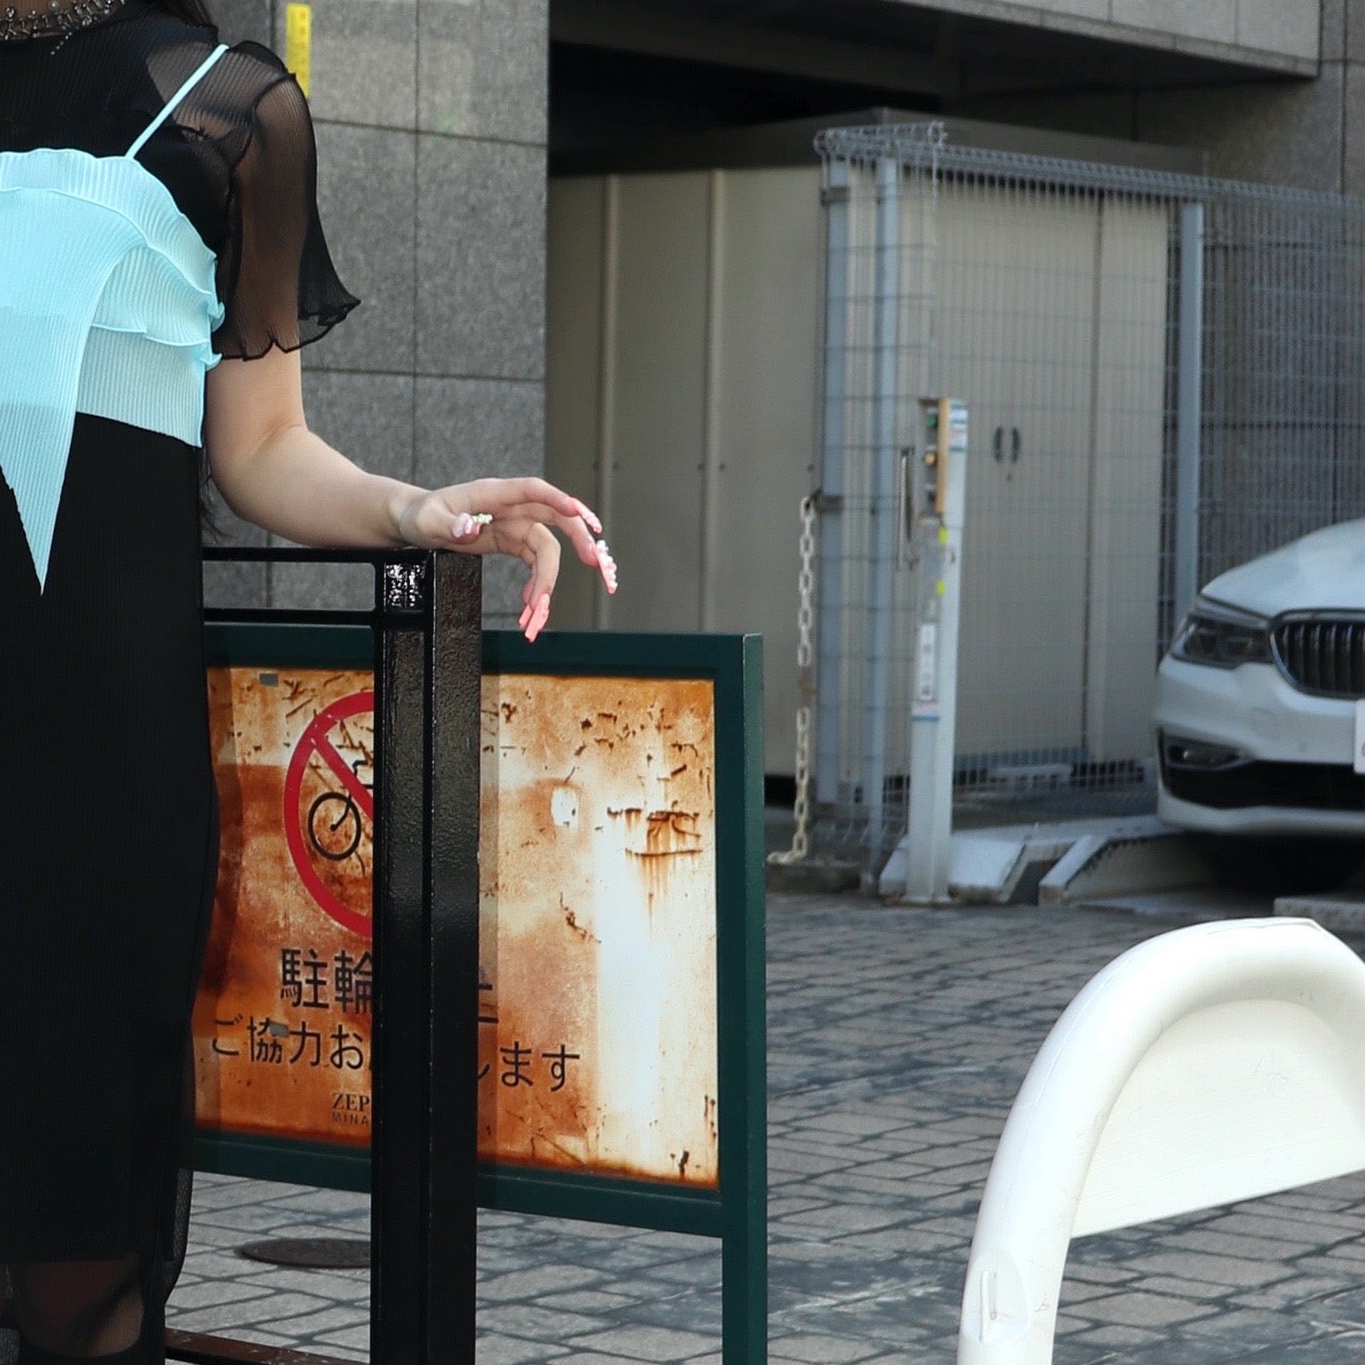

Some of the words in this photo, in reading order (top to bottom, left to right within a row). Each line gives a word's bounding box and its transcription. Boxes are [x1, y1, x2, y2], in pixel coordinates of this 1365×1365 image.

[211, 1013, 581, 1093] ご協力おます
[331, 1092, 371, 1112] ZEP
[331, 1112, 371, 1126] MINA
